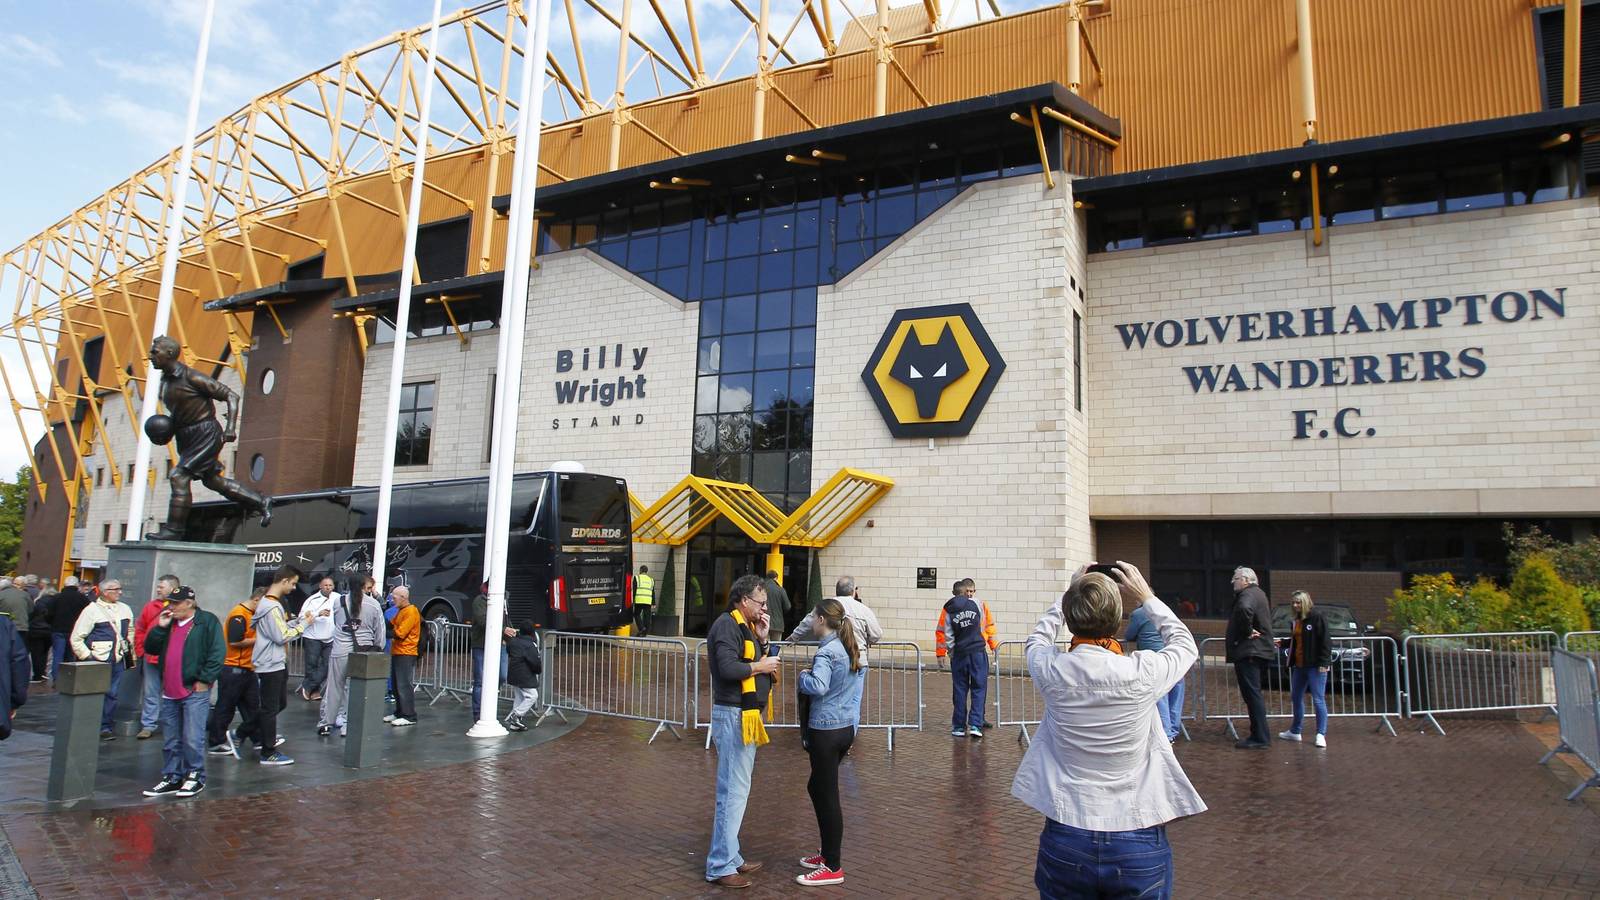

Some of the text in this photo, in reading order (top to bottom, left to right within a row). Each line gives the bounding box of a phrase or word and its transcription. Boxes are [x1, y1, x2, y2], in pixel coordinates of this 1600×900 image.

[1114, 287, 1568, 351] WOLVERHAMPTON
[556, 343, 648, 373] Billy
[1182, 346, 1488, 394] WANDERERS
[555, 374, 647, 407] Wright
[552, 413, 644, 430] STAND
[1292, 407, 1377, 440] F.C.
[571, 527, 621, 538] EDWARDS
